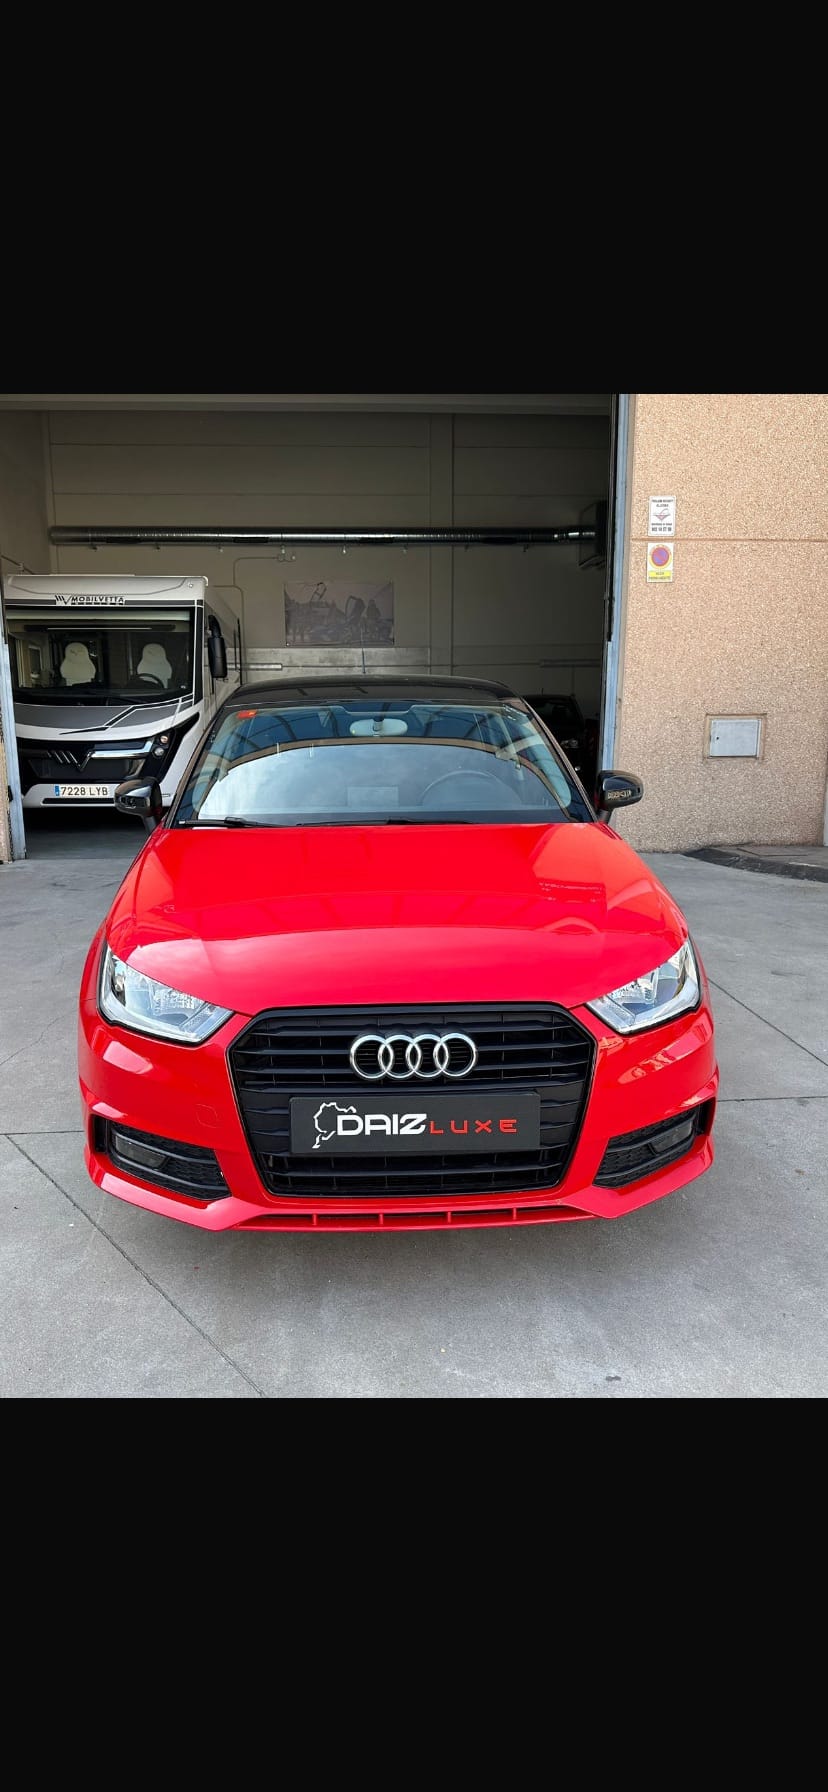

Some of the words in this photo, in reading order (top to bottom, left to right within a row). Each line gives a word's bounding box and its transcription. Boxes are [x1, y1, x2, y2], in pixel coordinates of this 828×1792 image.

[71, 596, 124, 604] MOBILVETTA
[61, 786, 86, 796] 7228
[89, 786, 108, 796] LYB
[336, 1113, 428, 1136] DAIZ
[429, 1119, 518, 1135] LUXE
